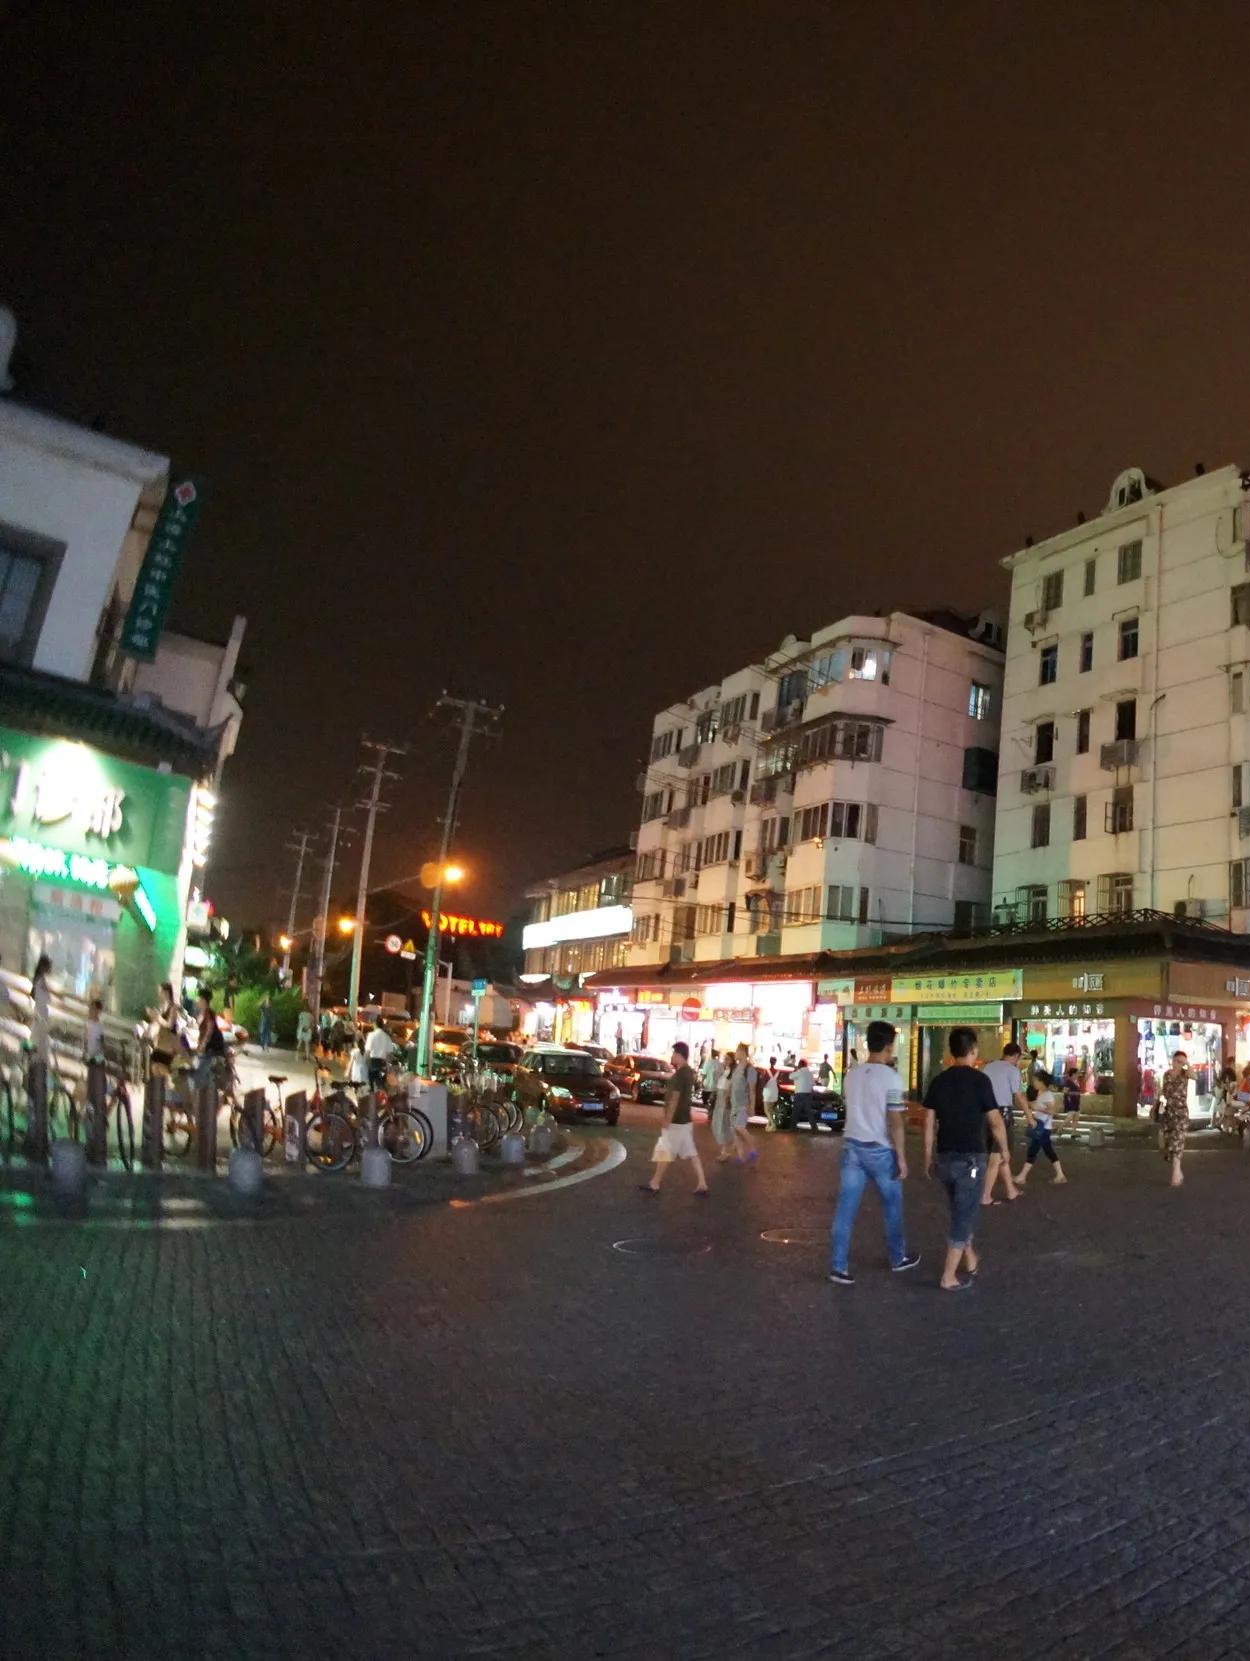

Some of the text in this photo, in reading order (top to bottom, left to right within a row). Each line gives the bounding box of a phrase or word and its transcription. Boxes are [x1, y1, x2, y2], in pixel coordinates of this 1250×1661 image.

[914, 976, 997, 991] 烟花爆竹专卖店
